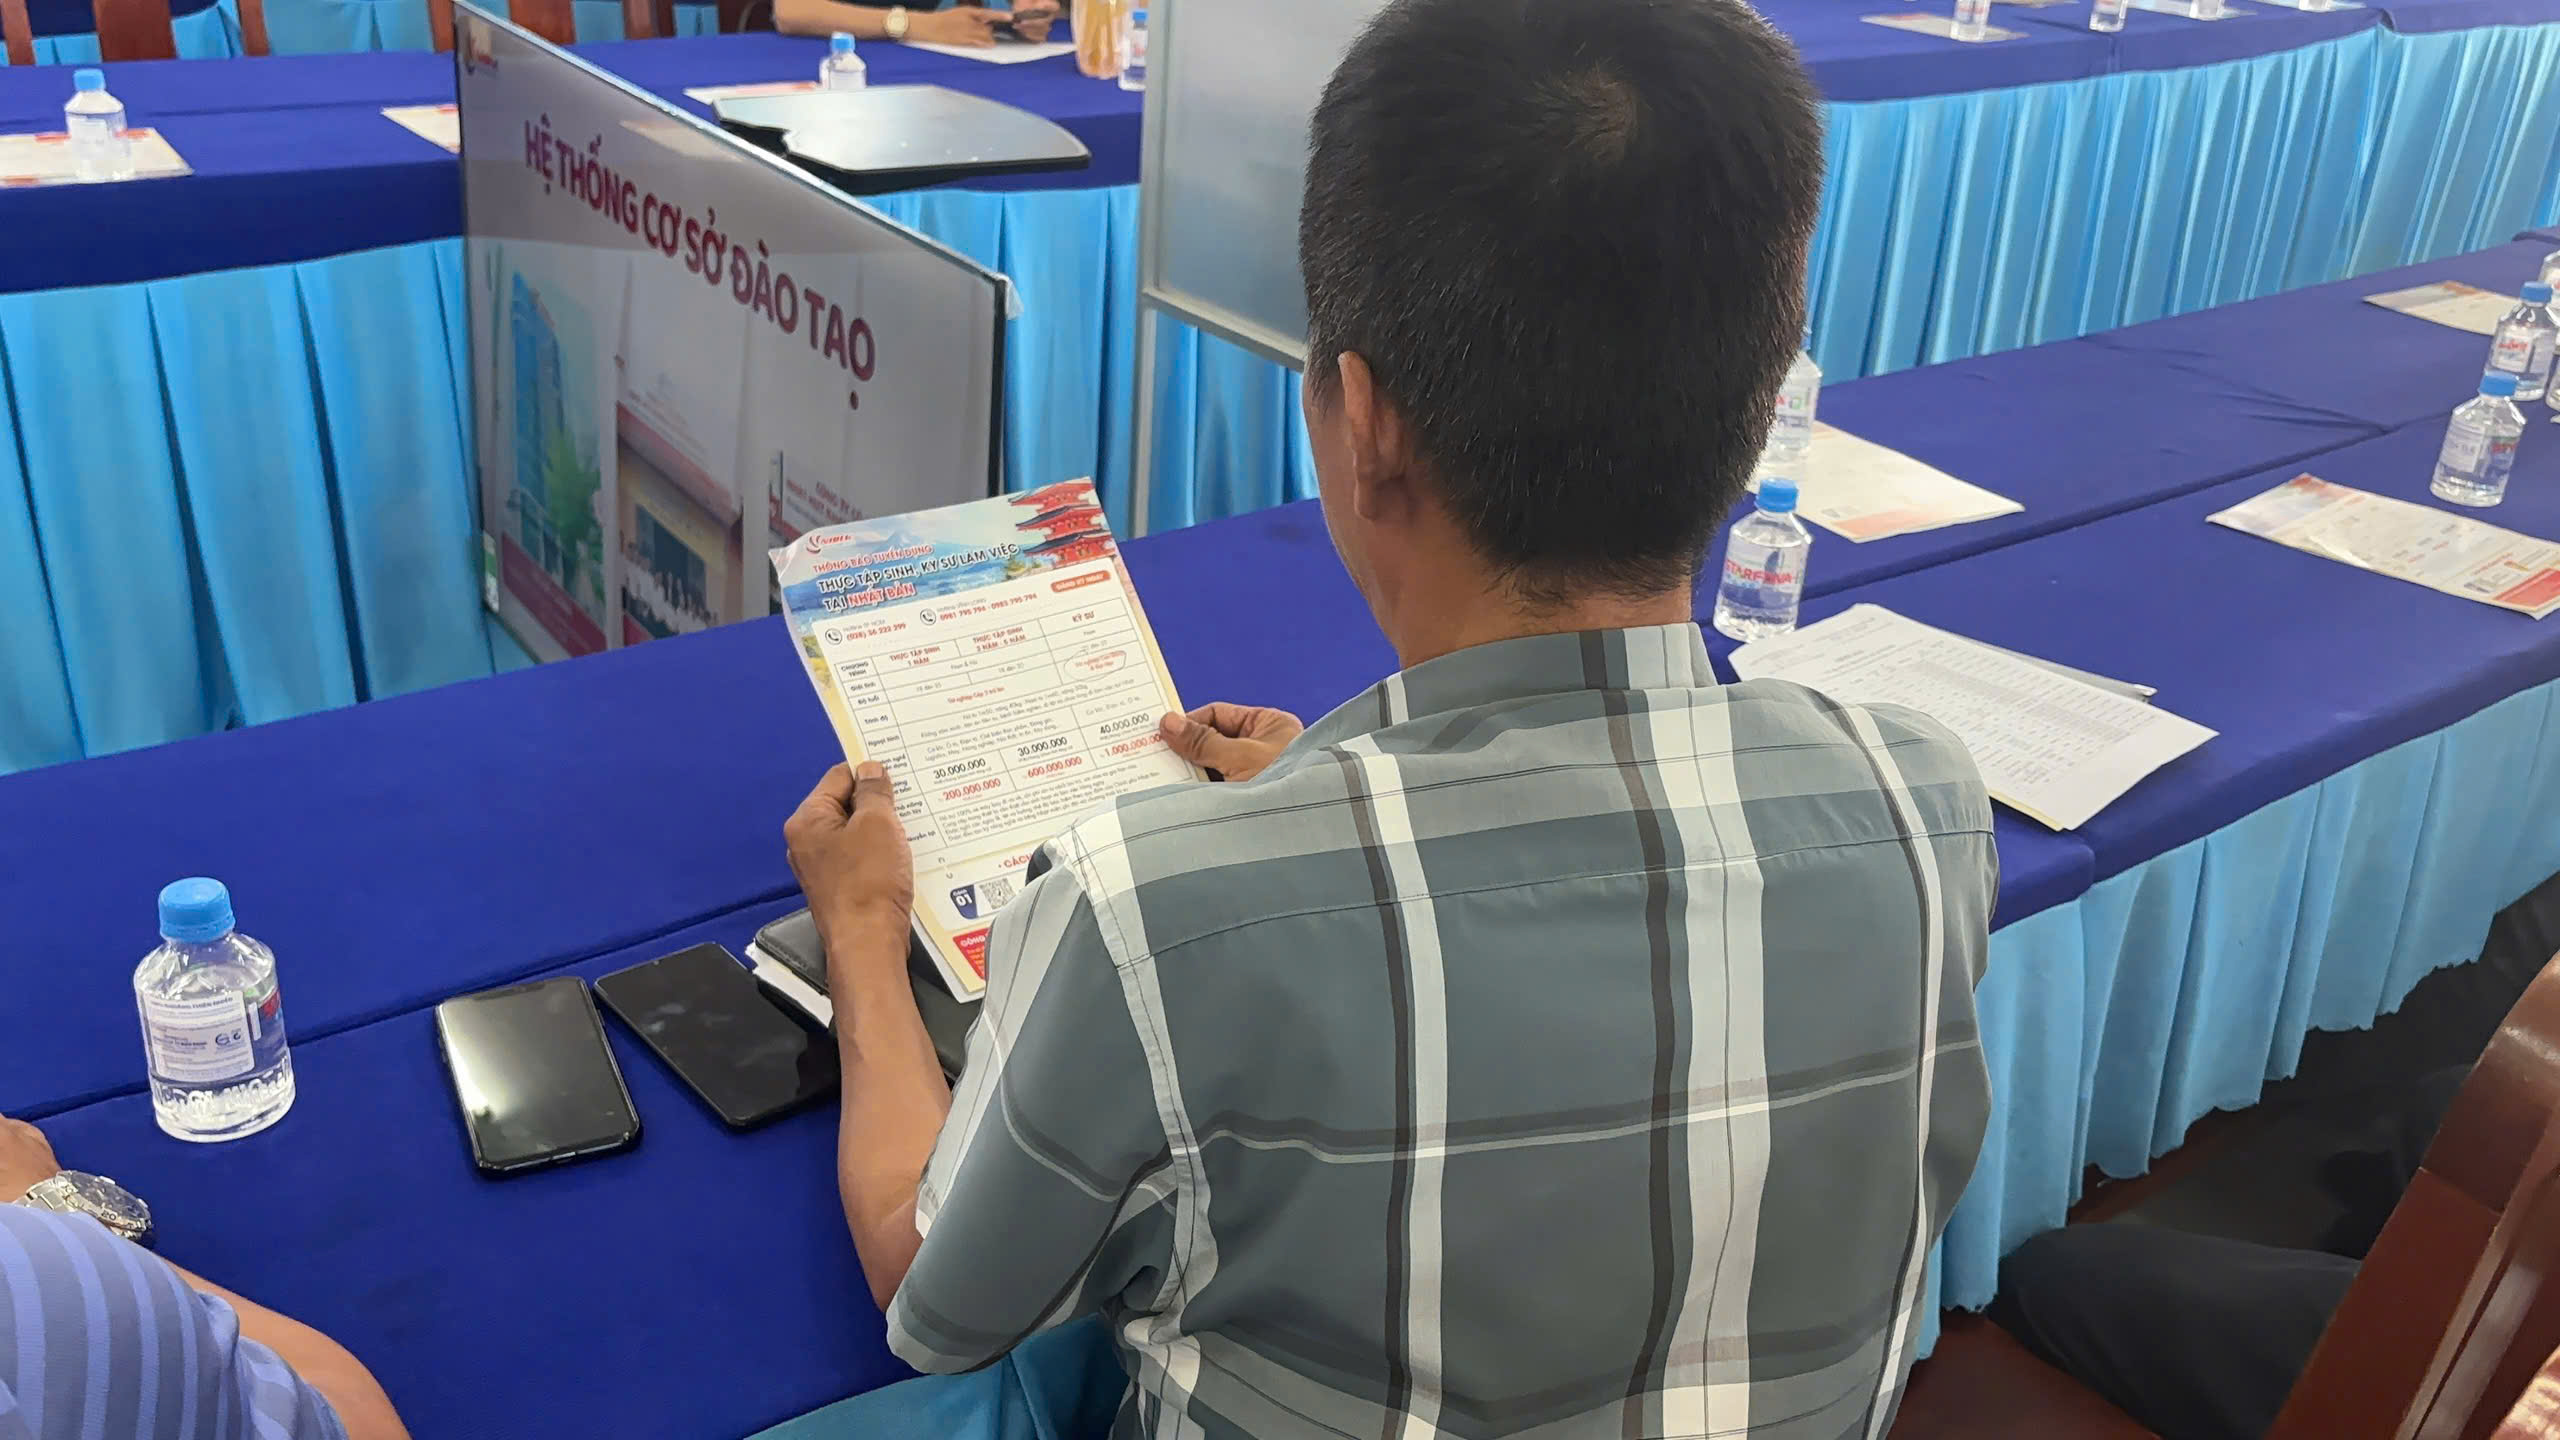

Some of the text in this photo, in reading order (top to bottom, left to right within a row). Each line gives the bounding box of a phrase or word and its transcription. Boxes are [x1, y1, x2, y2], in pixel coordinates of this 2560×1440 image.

[524, 113, 876, 411] HỆ THỐNG CƠ SỞ ĐÀO TẠO
[813, 559, 848, 574] THÔNG
[849, 553, 872, 566] BÁO
[819, 575, 856, 594] THỰC
[856, 568, 883, 587] TẬP
[884, 564, 920, 581] SINH,
[940, 556, 959, 568] SƯ
[988, 542, 1020, 560] VIỆC
[825, 580, 915, 612] TẠI NHẬT BẢN
[1099, 714, 1150, 733] 40.000.000
[1017, 737, 1068, 756] 30.000.000
[934, 759, 986, 778] 30.000.000
[1028, 756, 1083, 777] 600.000.000
[944, 779, 1001, 800] 200.000.000
[957, 894, 973, 906] 01
